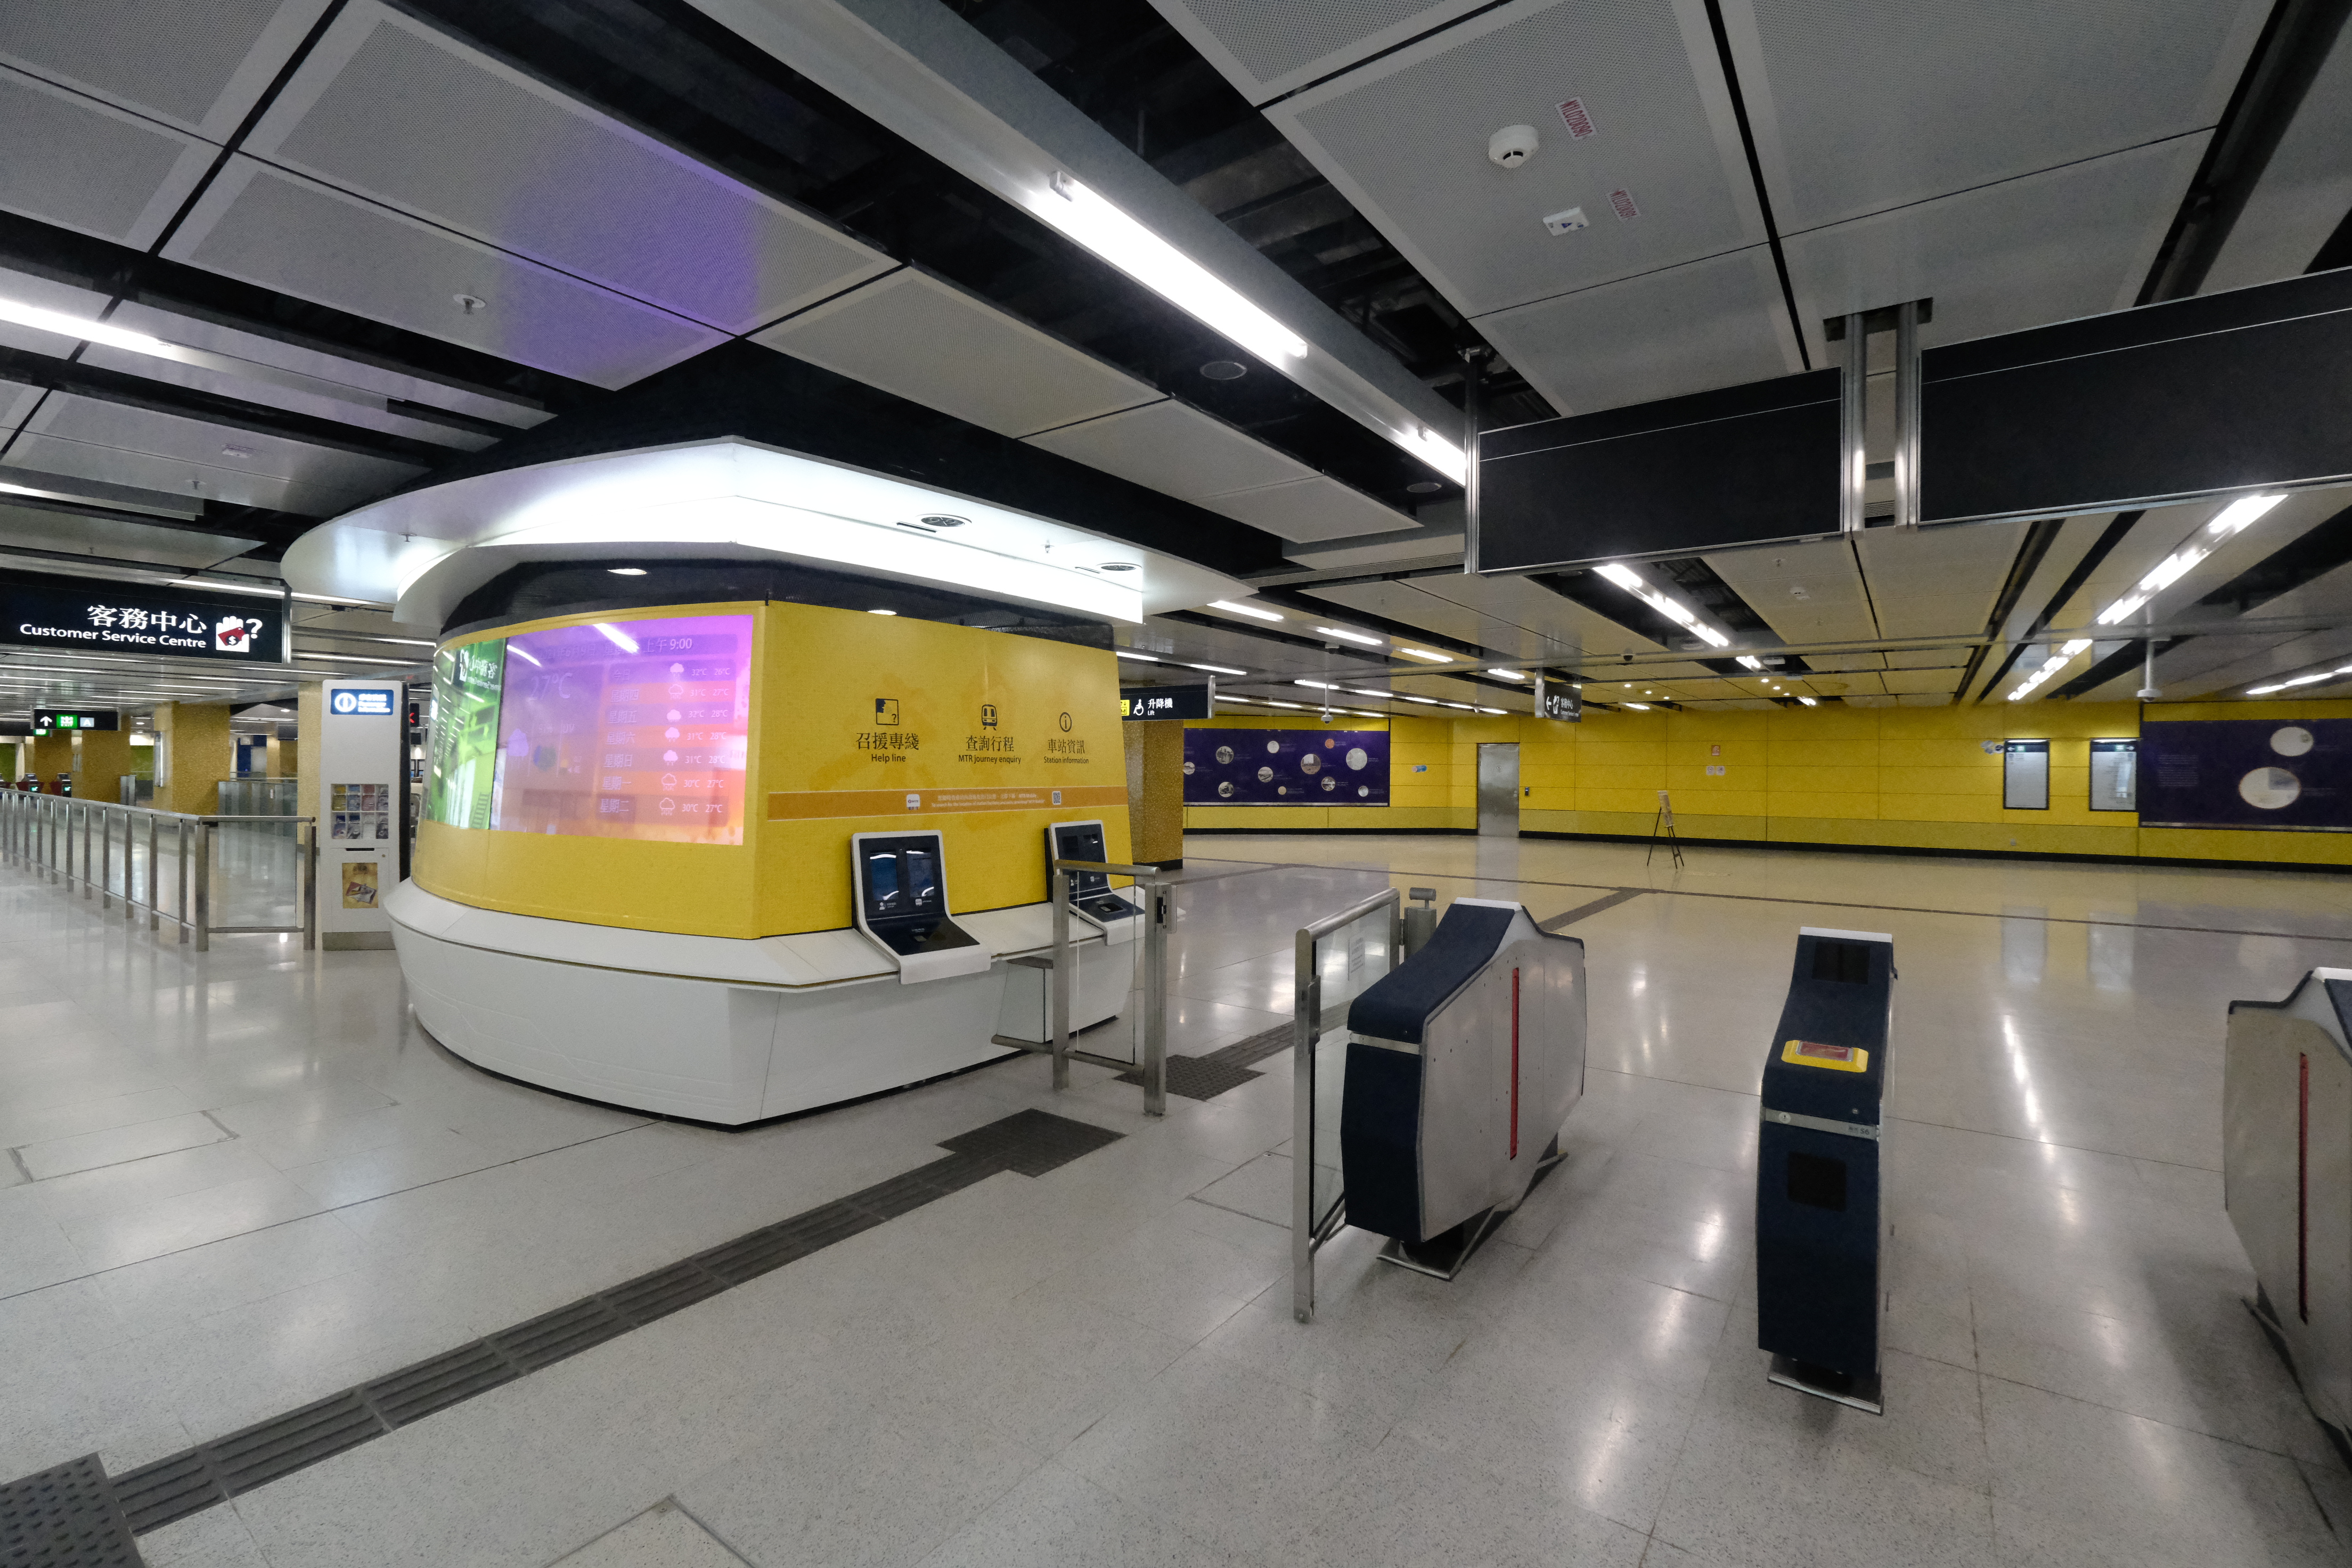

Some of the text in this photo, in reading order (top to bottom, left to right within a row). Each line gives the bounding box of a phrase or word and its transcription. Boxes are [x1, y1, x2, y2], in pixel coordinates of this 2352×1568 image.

[87, 605, 207, 634] 客務中心
[20, 624, 206, 648] Customer Service Centre
[643, 638, 667, 652] 上午
[669, 638, 692, 650] 9:00
[614, 669, 631, 681] 今日
[611, 689, 639, 703] 星期四
[1148, 698, 1173, 709] 升降機
[608, 710, 637, 724] 星期五
[606, 732, 635, 745] 星期六
[856, 732, 919, 750] 召援專綫
[966, 735, 1014, 752] 查詢行程
[1048, 739, 1085, 754] 車站資訊
[604, 754, 633, 768] 星期日
[871, 754, 889, 764] Help
[974, 755, 997, 764] journey
[999, 755, 1021, 764] enquiry
[602, 776, 631, 790] 星期一
[600, 799, 629, 813] 星期二
